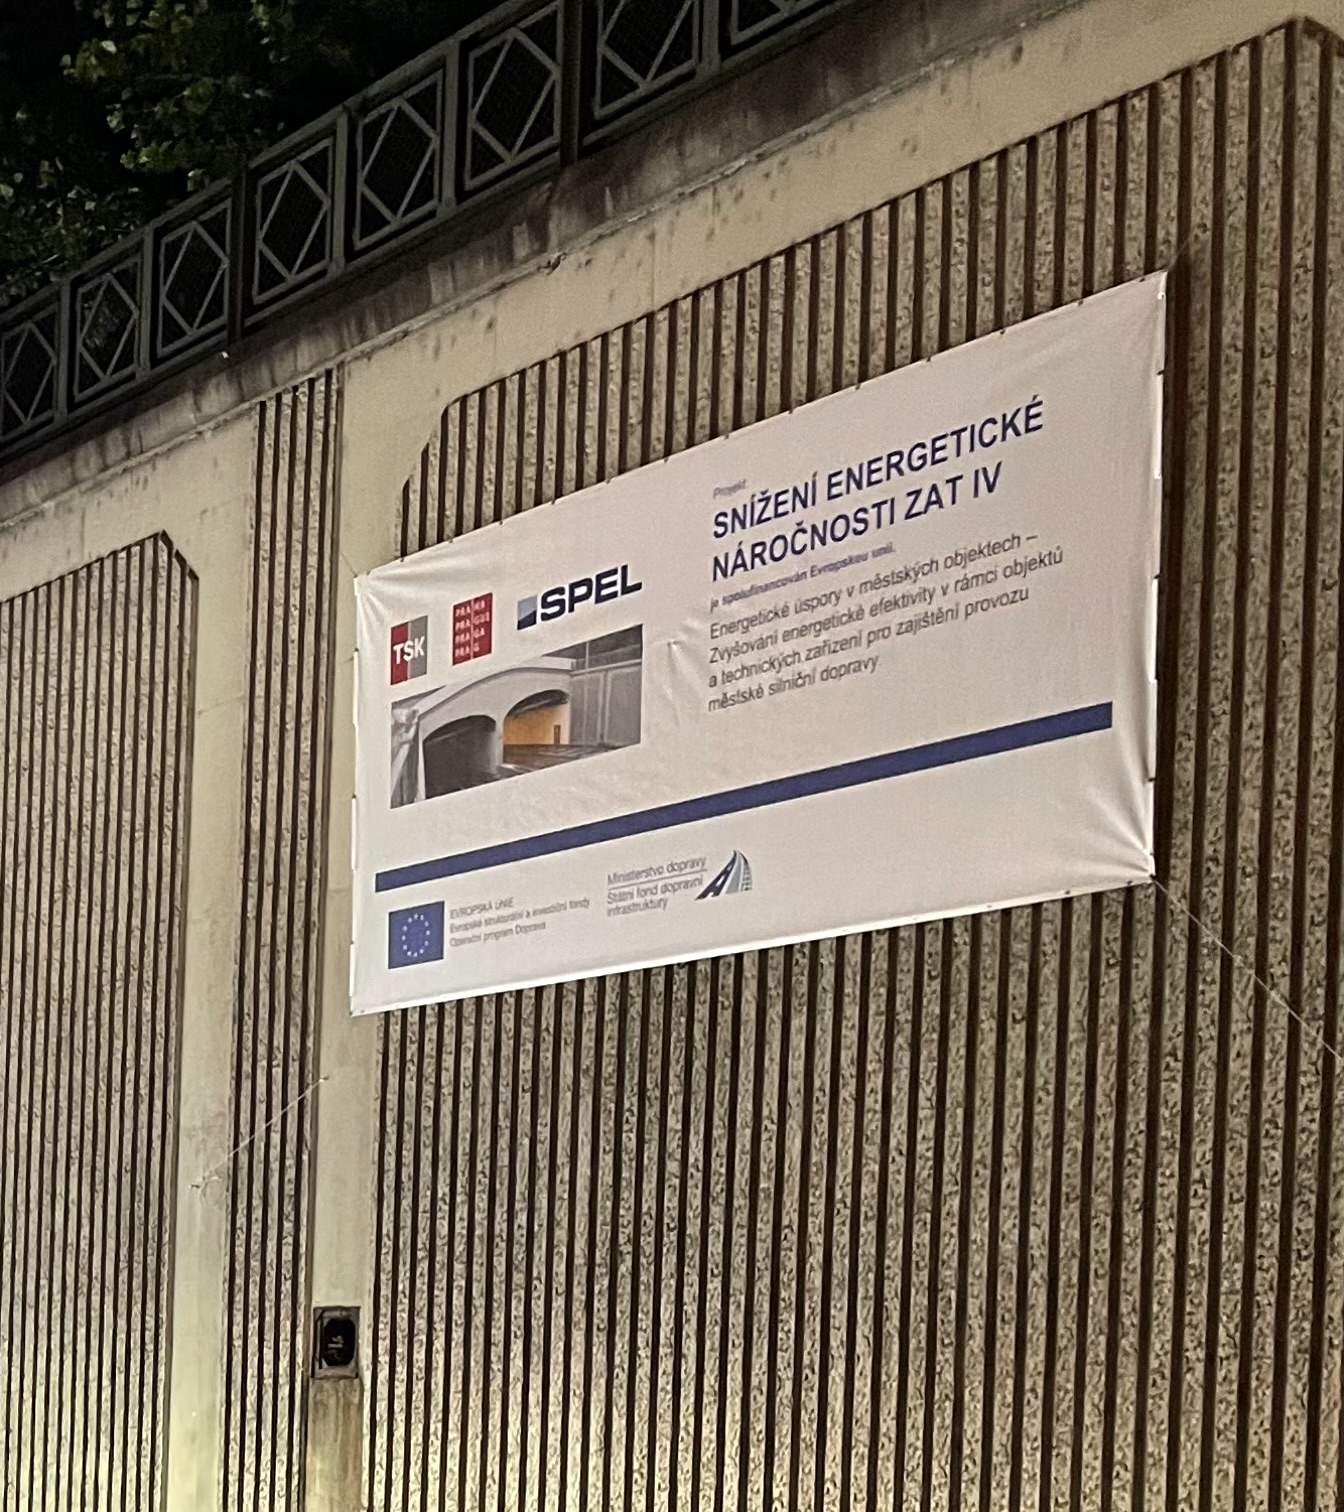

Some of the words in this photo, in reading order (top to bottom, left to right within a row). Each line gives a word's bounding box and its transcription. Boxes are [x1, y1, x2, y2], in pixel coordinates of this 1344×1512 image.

[714, 471, 818, 539] SNÍŽENÍ
[827, 394, 1044, 501] ENERGETICKÉ
[713, 497, 896, 582] NÁROČNOSTI
[905, 474, 963, 520] ZAT
[972, 461, 1003, 498] IV
[540, 564, 642, 622] SPEL
[709, 629, 778, 663] Zvyšování
[782, 604, 865, 643] energetické
[869, 585, 936, 618] efektivity
[940, 583, 949, 597] v
[954, 565, 998, 593] rámci
[1003, 545, 1063, 578] objektů
[710, 603, 789, 639] Energetické
[794, 588, 842, 613] úspory
[846, 585, 855, 597] v
[859, 558, 939, 595] městských
[944, 533, 1021, 569] objektech
[393, 635, 425, 665] TSK
[708, 685, 764, 712] městské
[820, 655, 879, 682] dopravy
[721, 649, 801, 684] technických
[805, 631, 862, 661] zařízení
[866, 625, 891, 648] pro
[896, 602, 959, 636] zajištění
[964, 587, 1030, 620] provozu
[666, 857, 707, 875] dopravy
